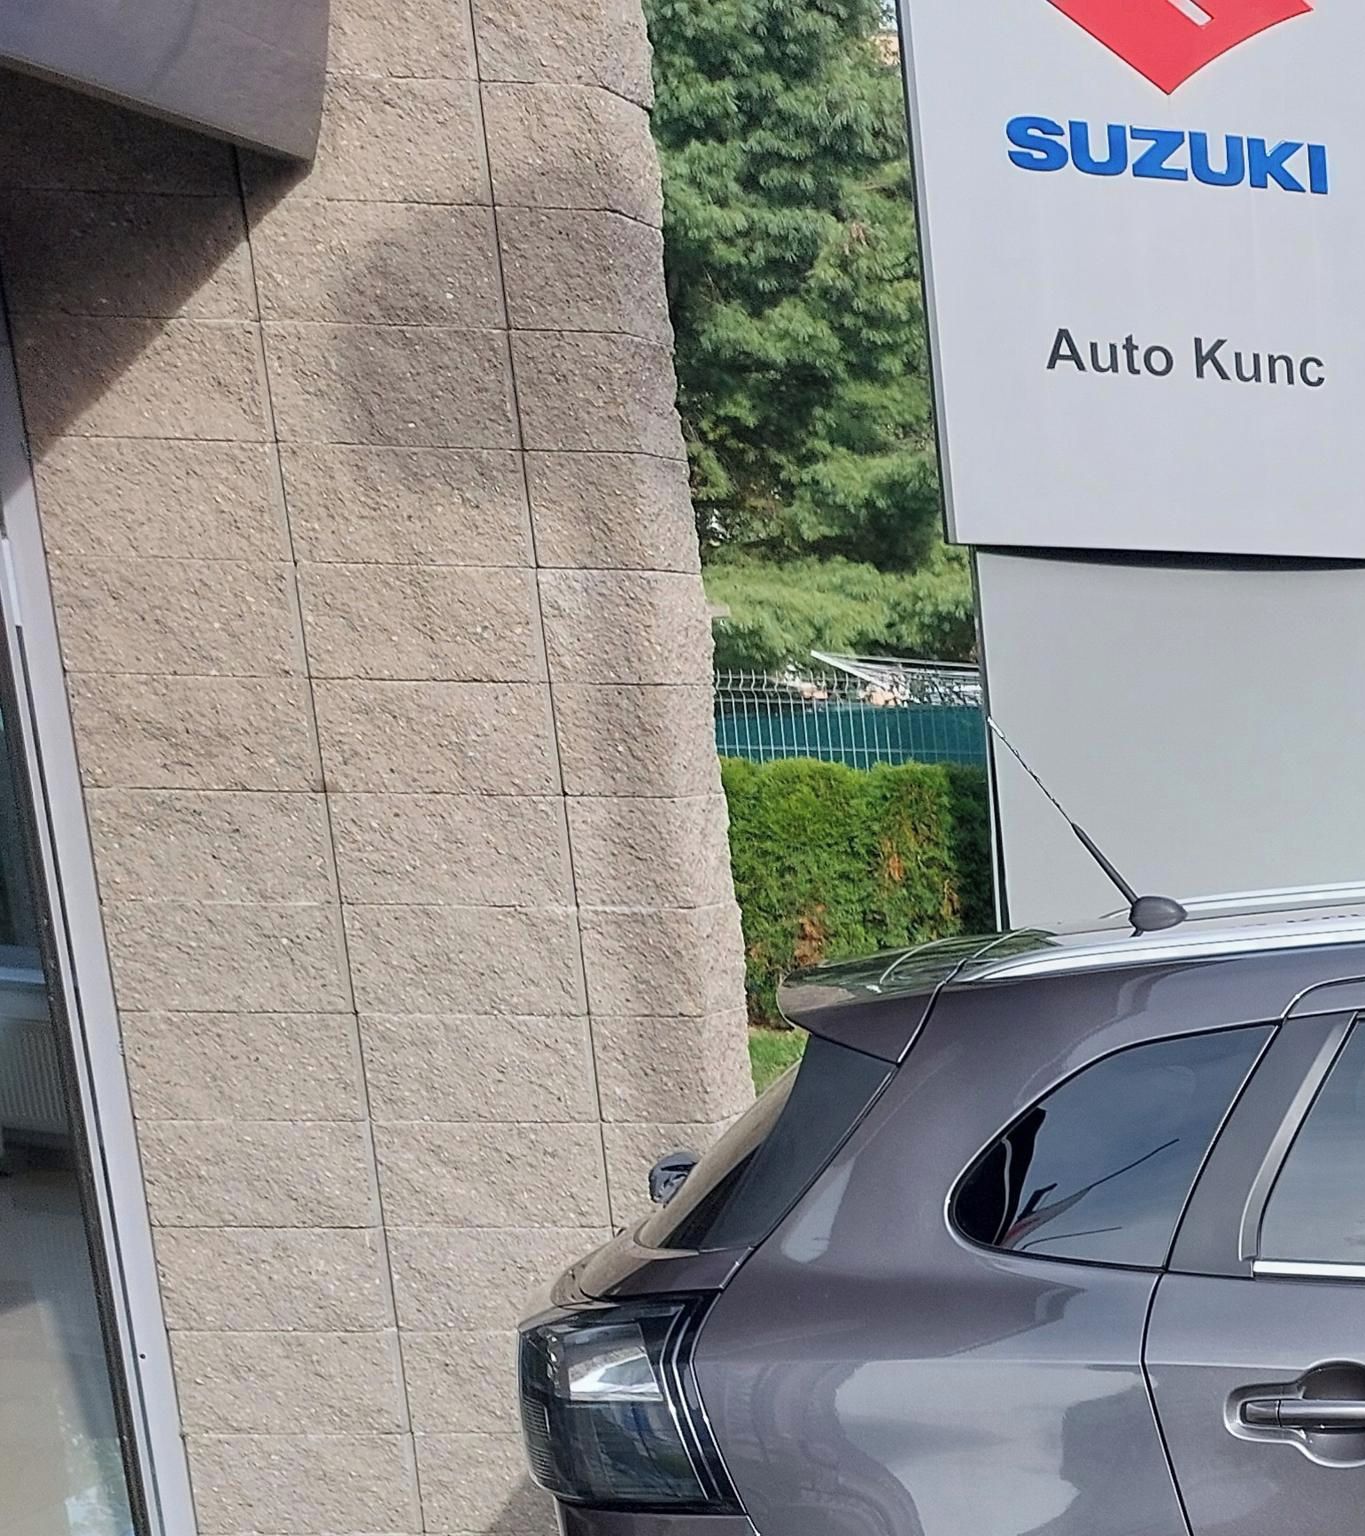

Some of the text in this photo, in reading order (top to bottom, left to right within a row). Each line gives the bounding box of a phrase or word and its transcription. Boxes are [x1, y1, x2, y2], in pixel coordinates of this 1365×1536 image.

[1004, 115, 1329, 195] SUZUKI
[1046, 328, 1326, 389] Auto Kunc
